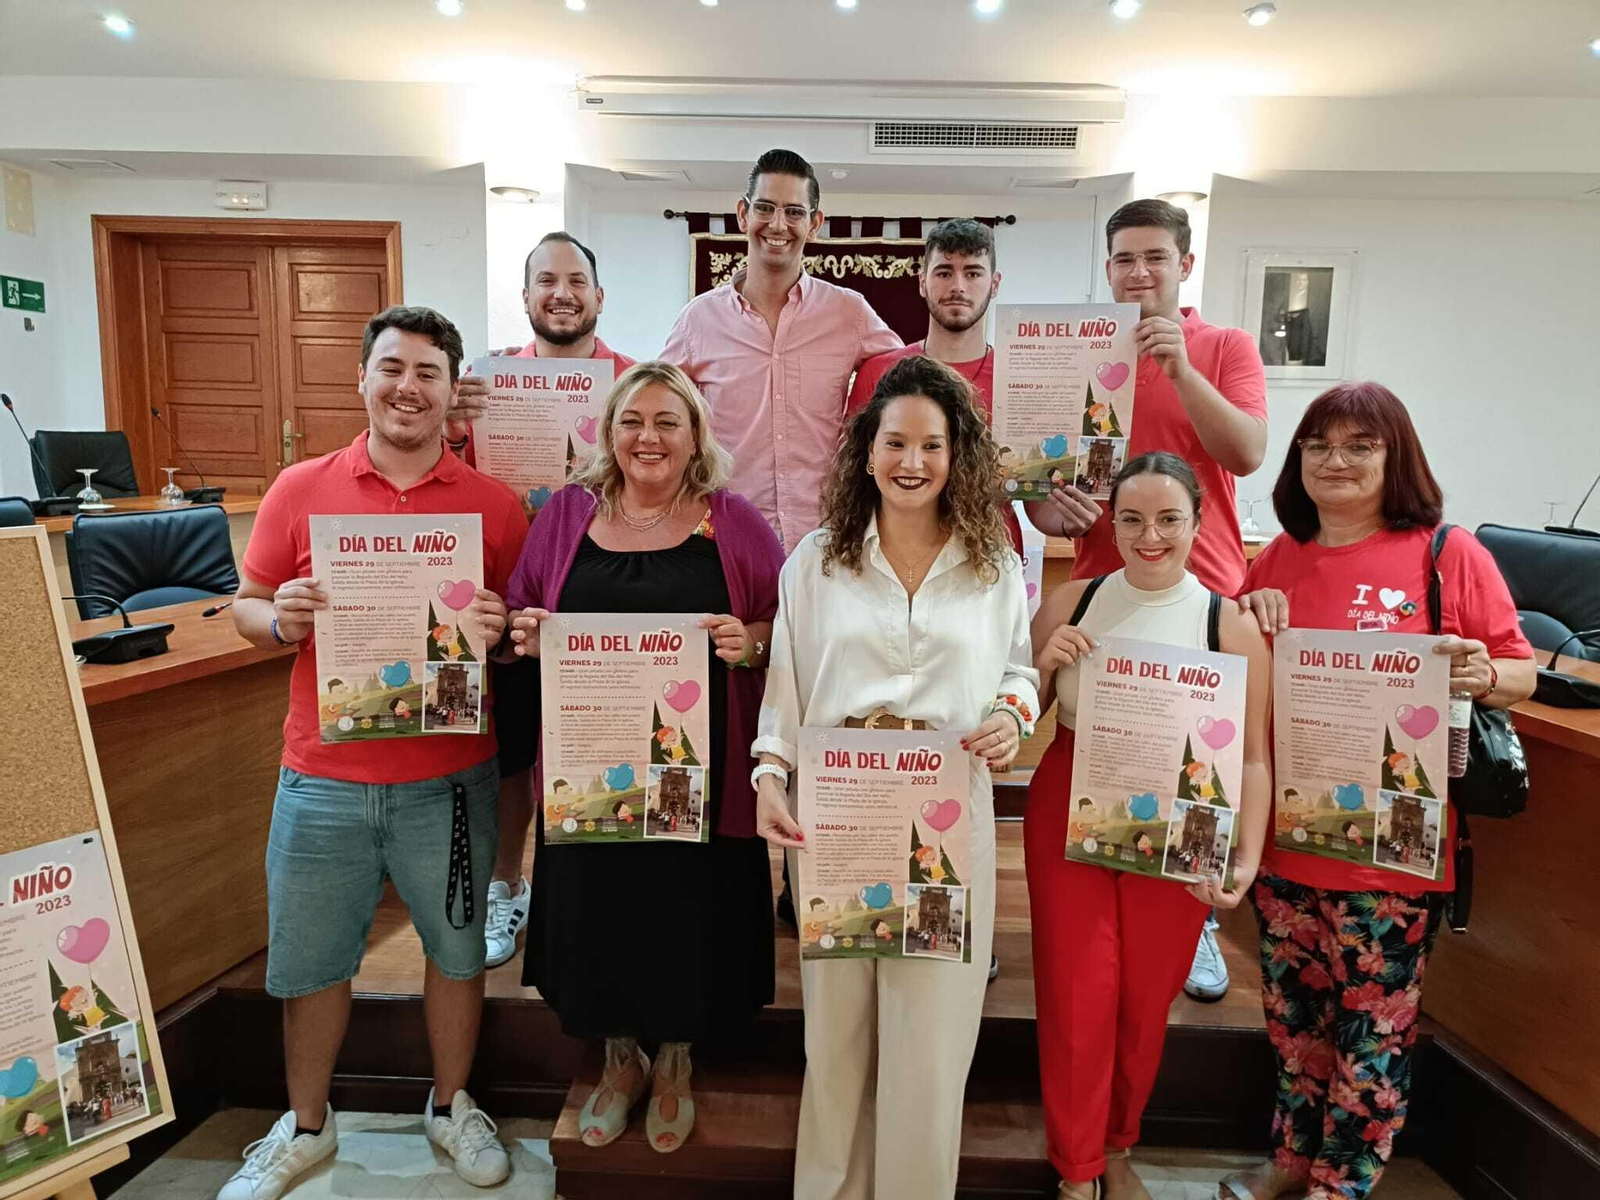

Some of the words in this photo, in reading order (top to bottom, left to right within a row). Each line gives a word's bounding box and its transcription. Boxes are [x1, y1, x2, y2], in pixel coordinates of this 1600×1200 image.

[1018, 321, 1040, 337] DÍA
[1046, 324, 1073, 336] DEL
[1078, 318, 1116, 338] NIÑO
[1090, 341, 1112, 349] 2023
[494, 372, 517, 388] DÍA
[523, 376, 550, 390] DEL
[555, 373, 592, 391] NIÑO
[340, 534, 367, 552] DÍA
[374, 537, 406, 552] DEL
[413, 530, 457, 552] NIÑO
[427, 557, 452, 566] 2023
[1352, 584, 1372, 605] I
[1348, 608, 1360, 618] DÍA
[1363, 611, 1375, 620] DEL
[568, 632, 595, 651] DÍA
[602, 636, 633, 651] DEL
[639, 629, 682, 652] NIÑO
[653, 656, 678, 666] 2023
[1300, 648, 1325, 667] DÍA
[1333, 653, 1365, 670] DEL
[1372, 651, 1420, 673] NIÑO
[1106, 656, 1133, 676] DÍA
[1140, 662, 1171, 681] DEL
[1177, 665, 1220, 689] NIÑO
[1096, 681, 1126, 689] VIERNES
[1387, 677, 1415, 688] 2023
[1190, 689, 1215, 702] 2023
[1291, 716, 1321, 726] SÁBADO
[1092, 724, 1121, 735] SÁBADO
[1123, 729, 1133, 737] 30
[825, 748, 851, 768] DÍA
[858, 753, 890, 769] DEL
[896, 749, 941, 772] NIÑO
[911, 776, 937, 785] 2023
[13, 864, 73, 904] NIÑO
[36, 895, 71, 915] 2023
